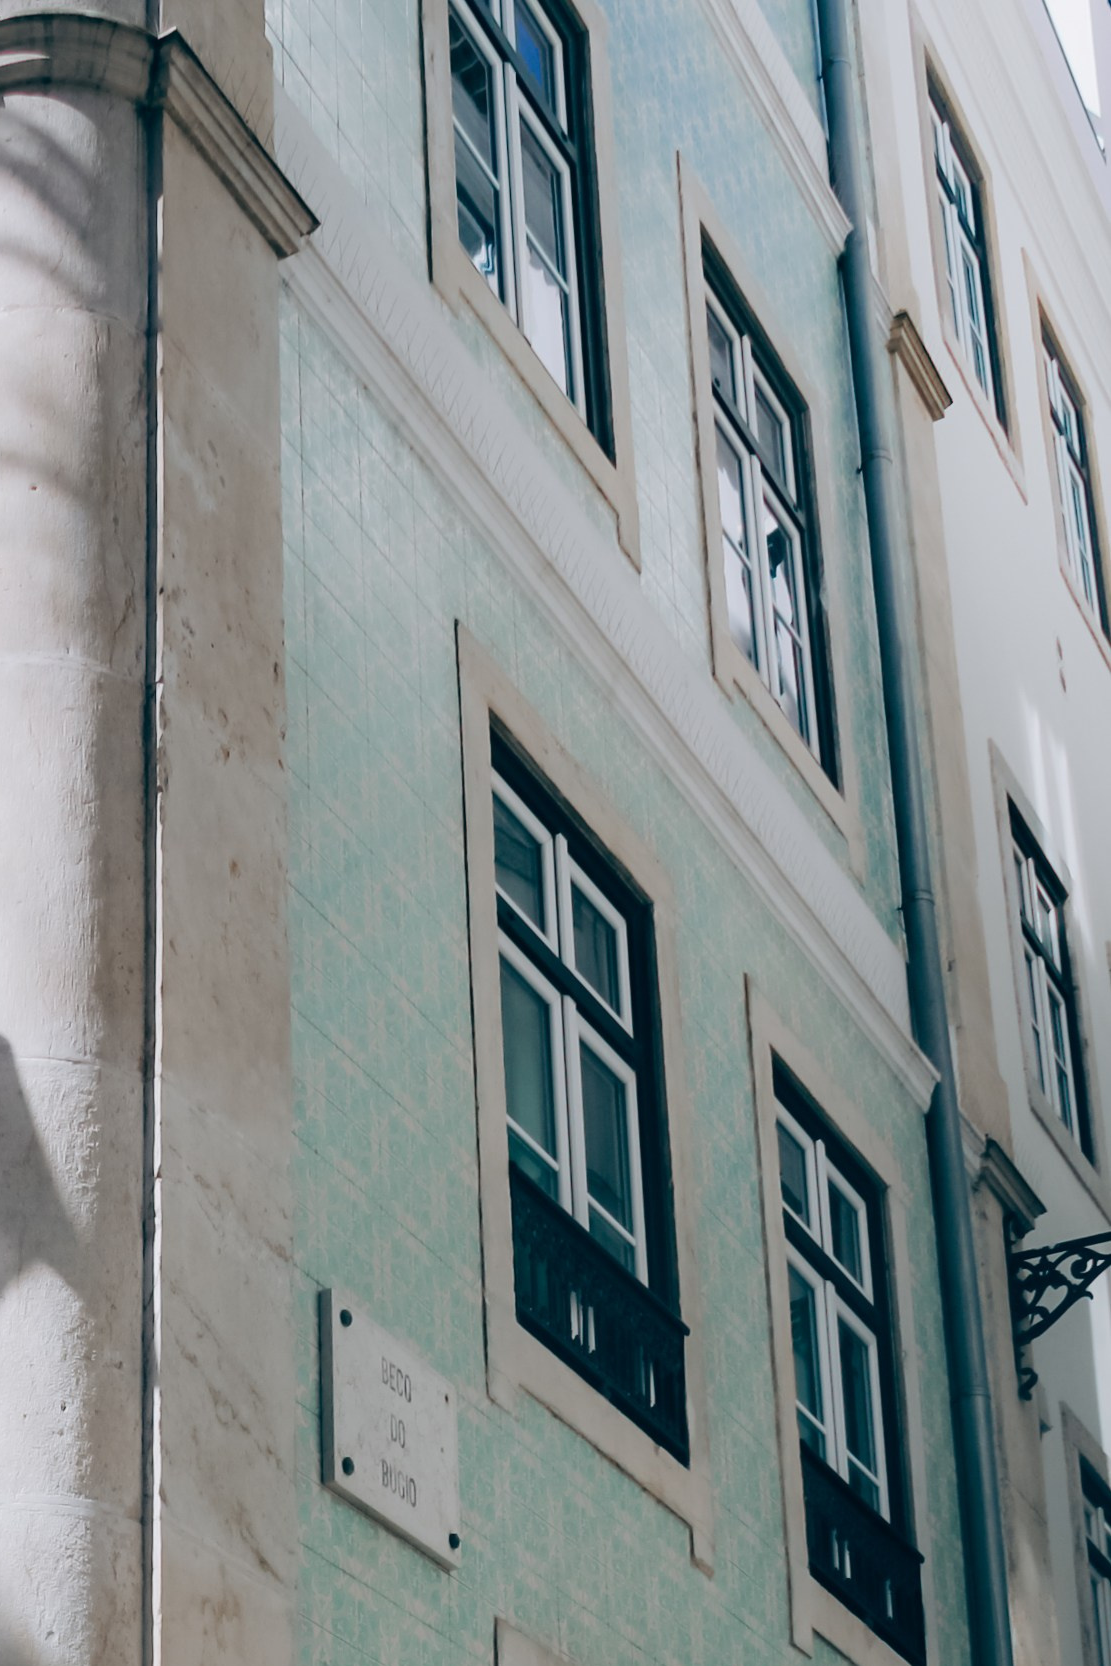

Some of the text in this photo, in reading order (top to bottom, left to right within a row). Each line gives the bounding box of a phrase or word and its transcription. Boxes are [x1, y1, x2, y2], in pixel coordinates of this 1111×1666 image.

[381, 1356, 412, 1403] BECO
[390, 1413, 406, 1448] DO
[381, 1459, 417, 1508] BUGIO
